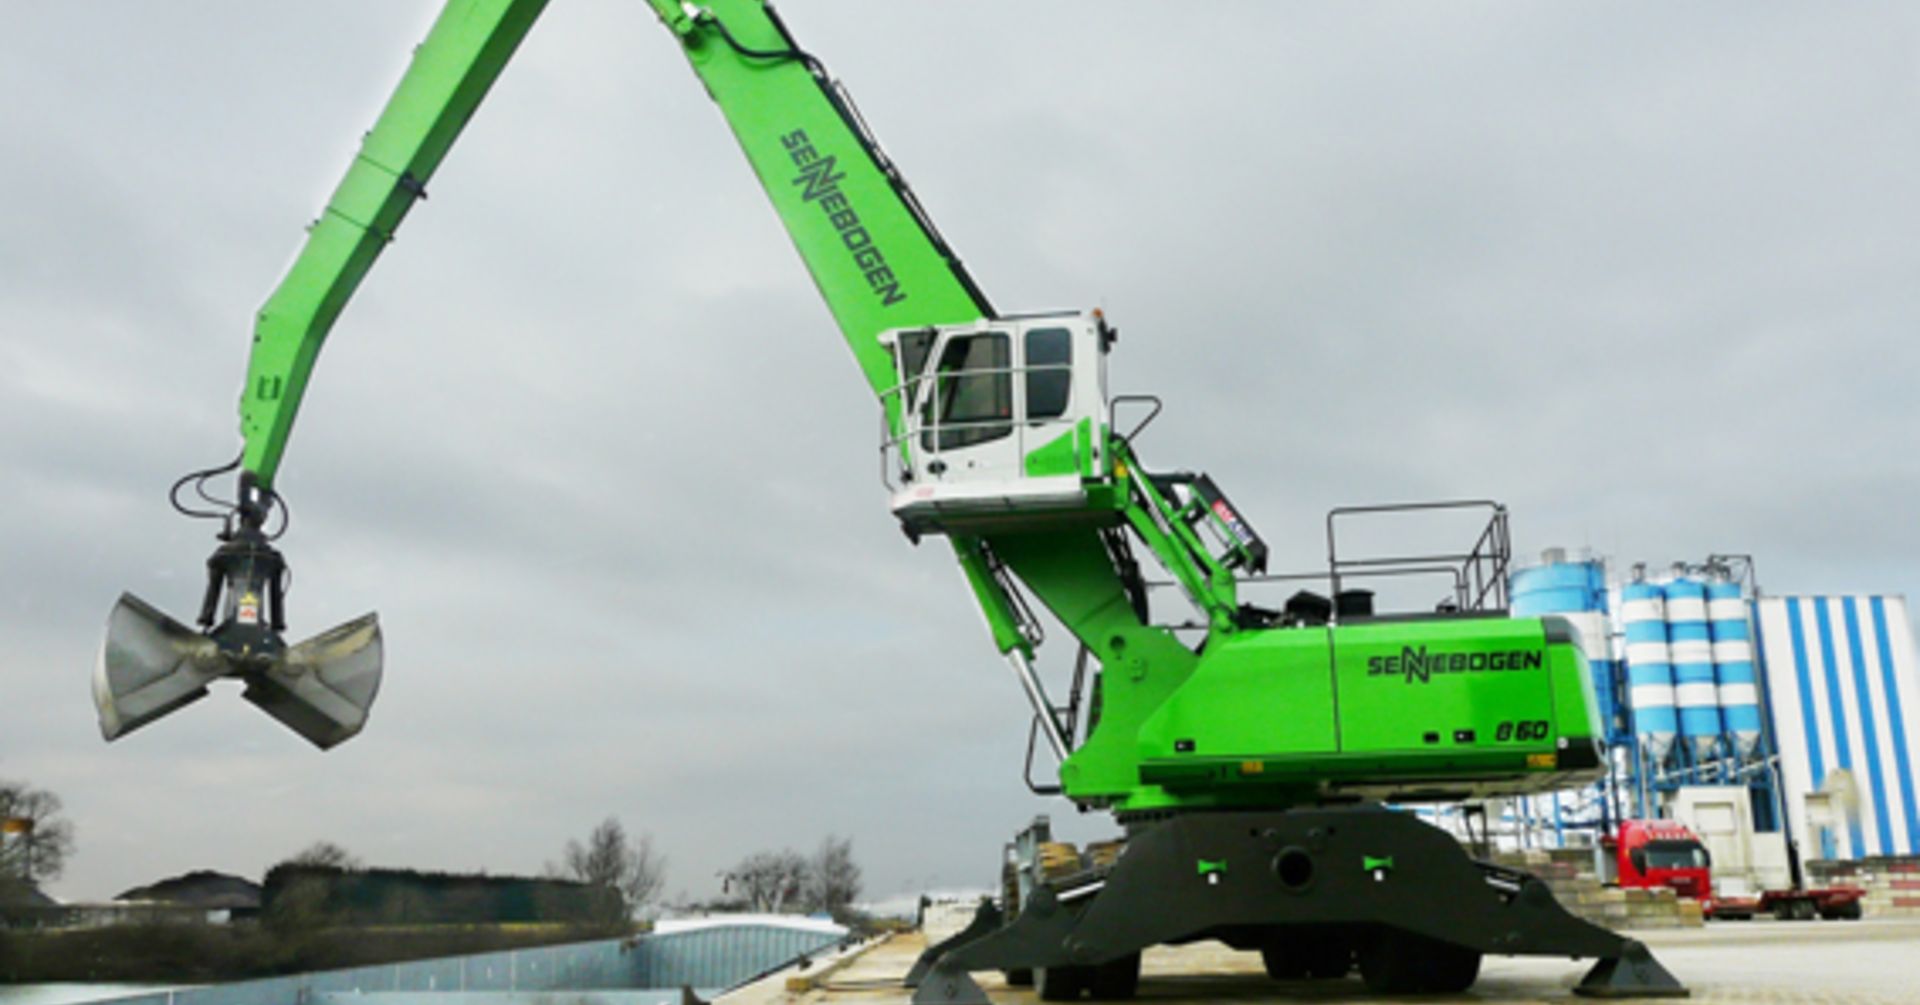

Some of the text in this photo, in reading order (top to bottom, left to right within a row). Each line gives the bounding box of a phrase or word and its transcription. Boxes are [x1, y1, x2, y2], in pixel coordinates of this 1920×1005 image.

[780, 128, 907, 307] SENNEBOGEN
[1367, 645, 1542, 684] SENNEBOGEN
[1495, 720, 1549, 741] 860
